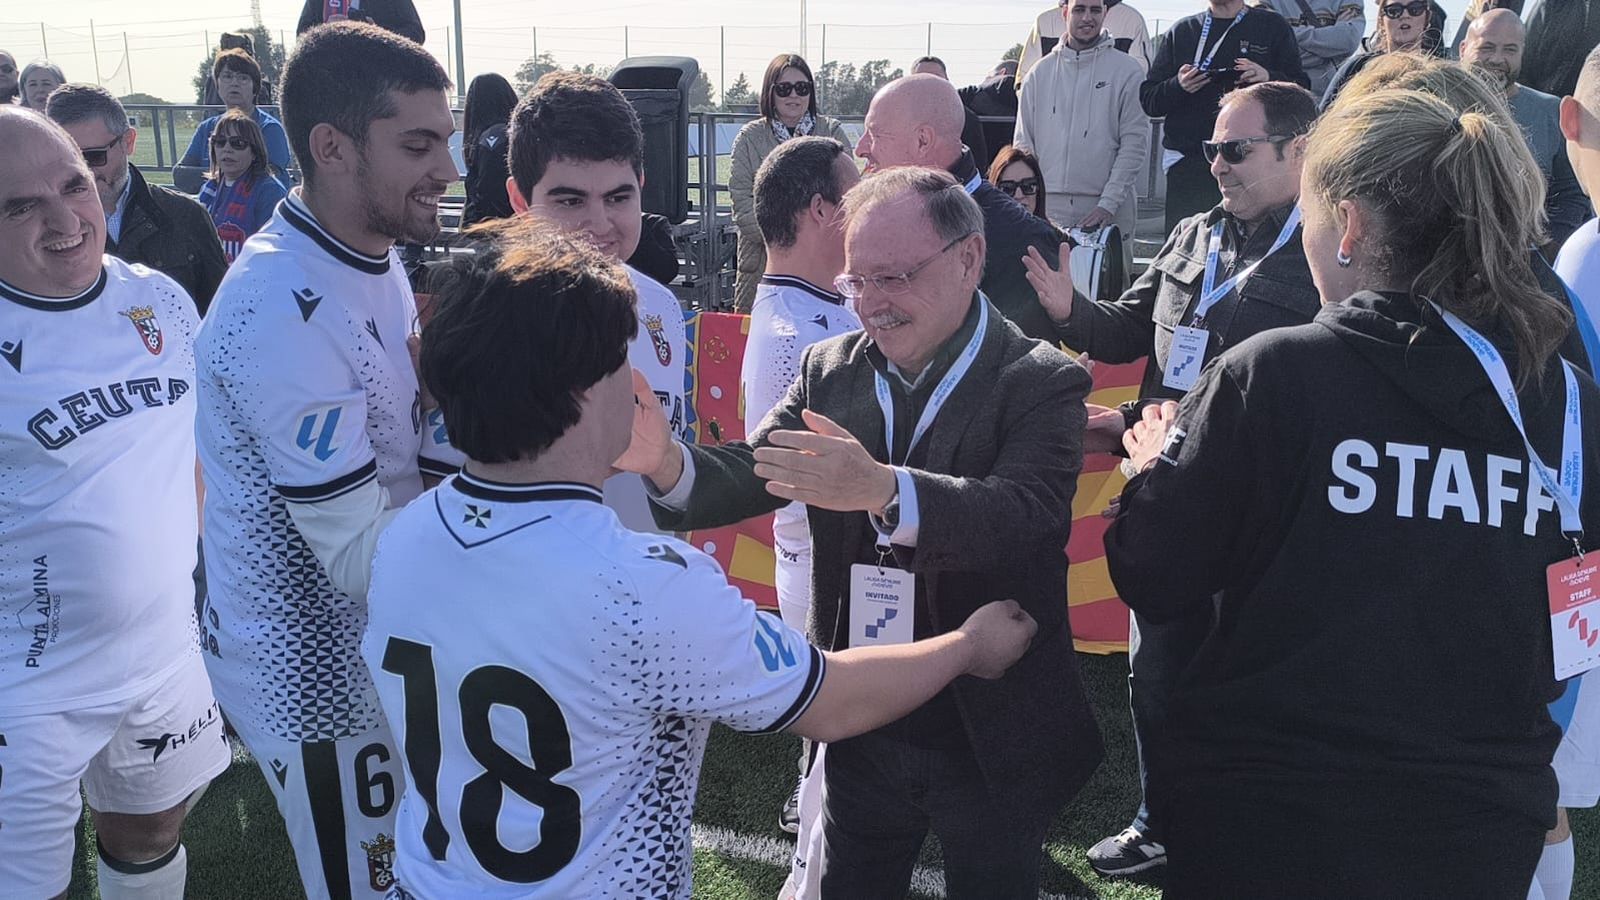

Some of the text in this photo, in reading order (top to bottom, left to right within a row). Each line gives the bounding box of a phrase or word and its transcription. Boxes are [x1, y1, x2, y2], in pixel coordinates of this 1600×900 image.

[27, 376, 190, 450] CEUTA
[1328, 438, 1559, 536] STAFF
[25, 554, 50, 668] PUNTA ALMINA
[865, 591, 899, 601] INVITADO
[1570, 588, 1592, 601] STAFF
[354, 742, 395, 818] 6
[381, 635, 581, 884] 18
